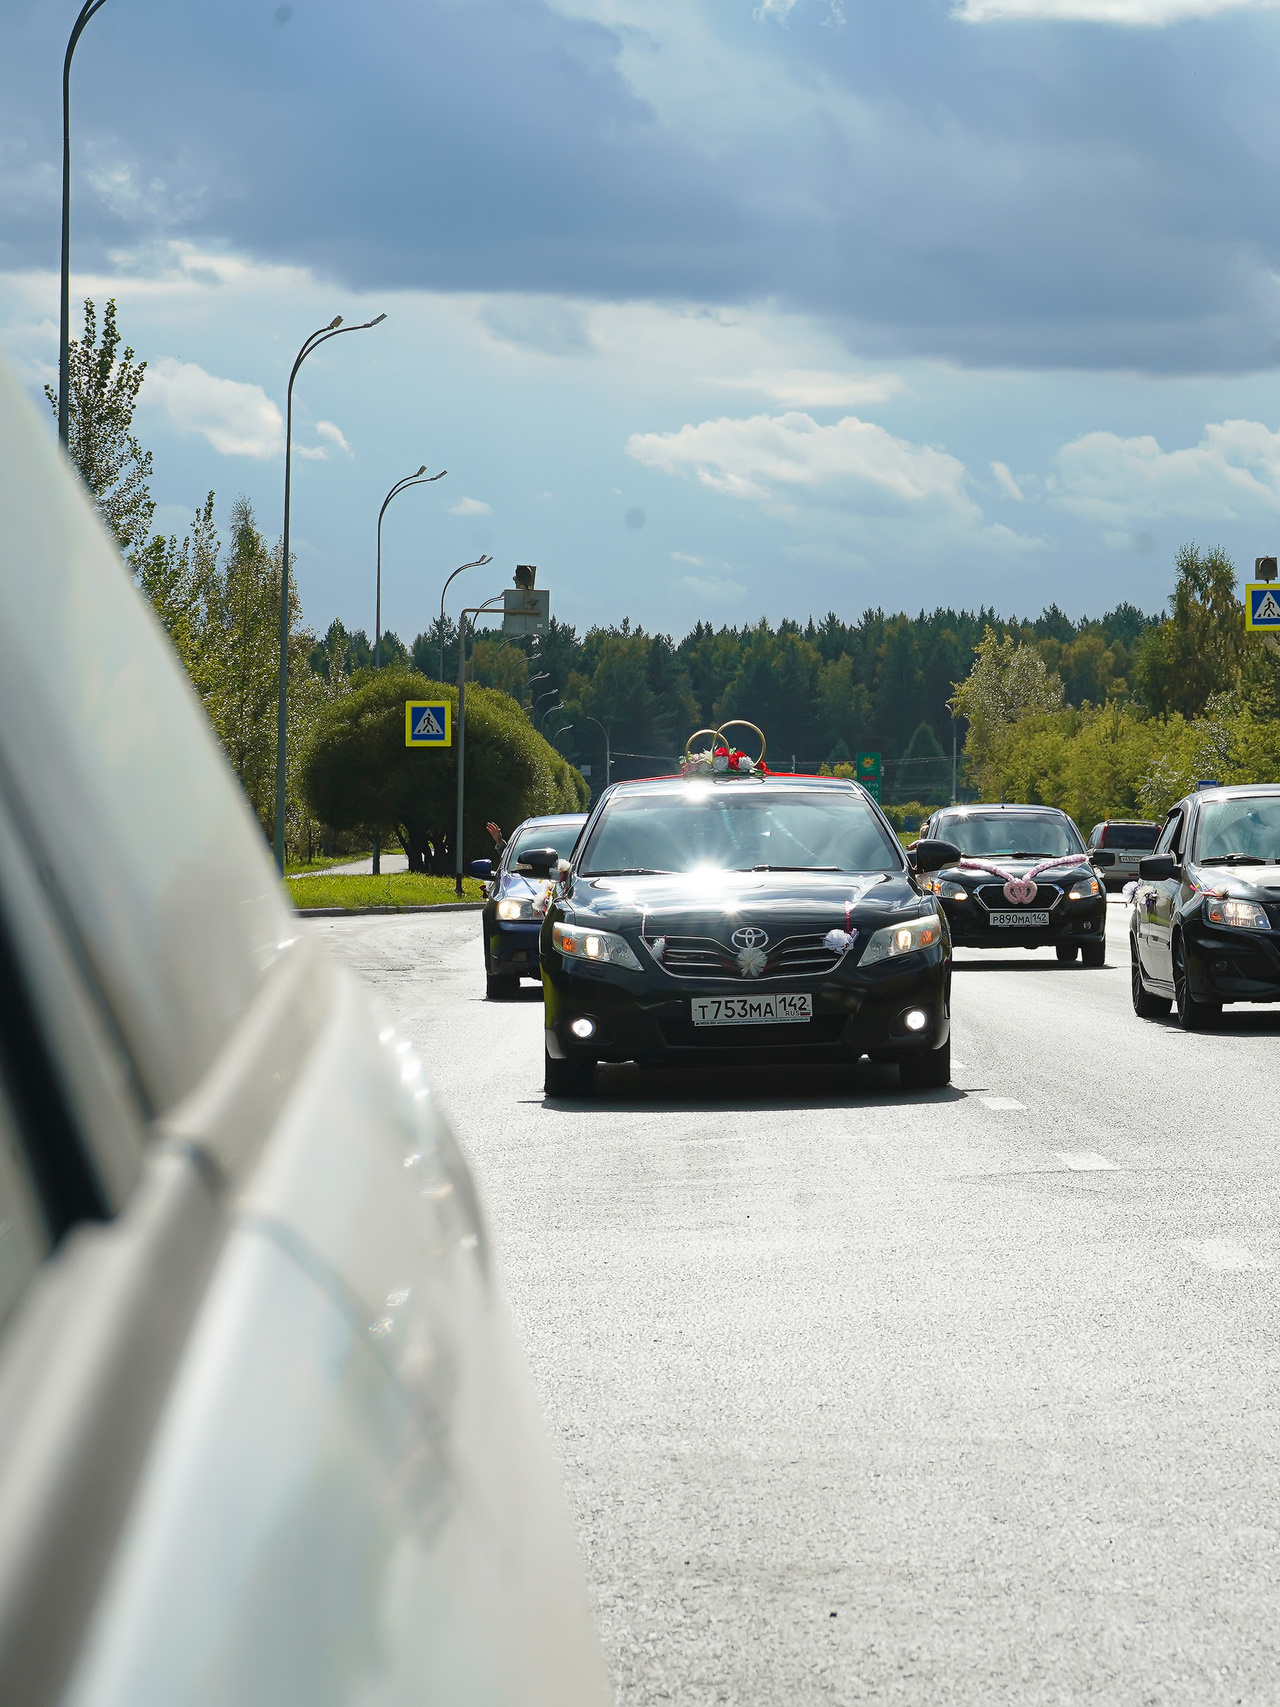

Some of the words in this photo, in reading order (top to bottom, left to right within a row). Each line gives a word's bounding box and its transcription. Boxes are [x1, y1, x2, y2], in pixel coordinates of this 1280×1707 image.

[1032, 913, 1048, 922] 142
[697, 999, 774, 1020] Т753МА
[778, 996, 807, 1011] 142
